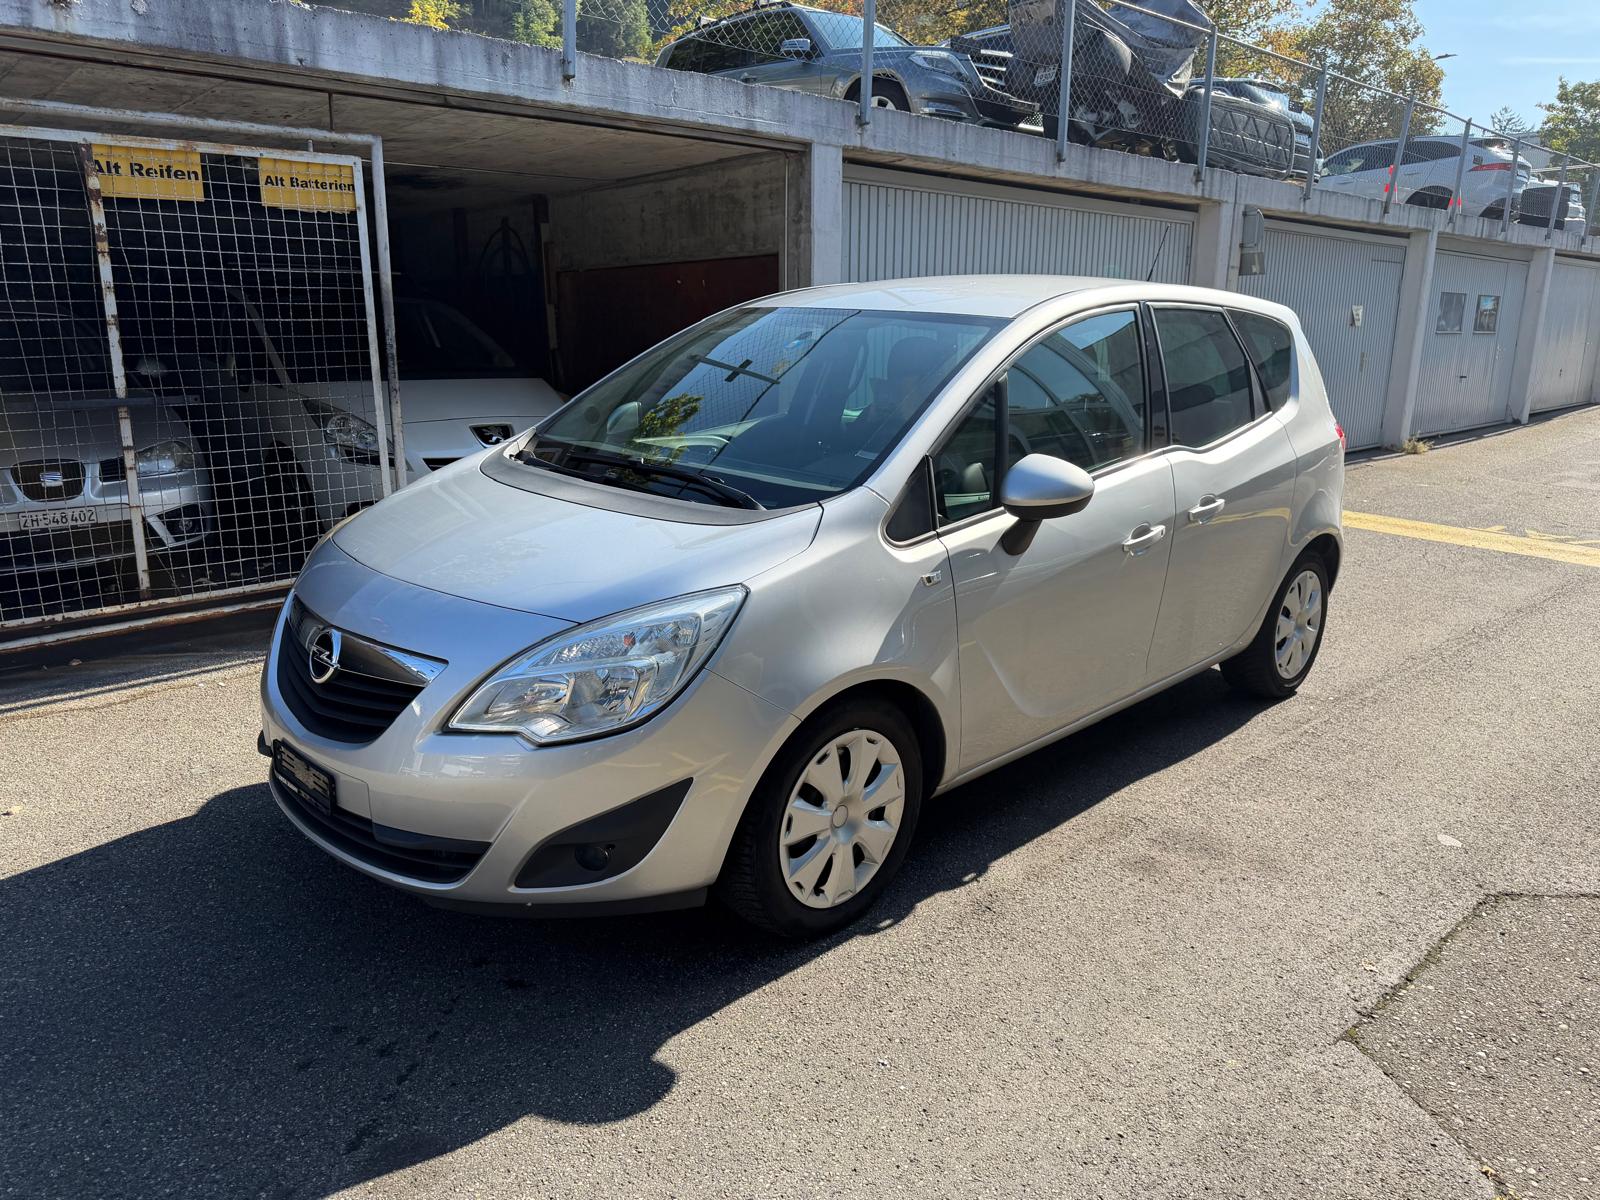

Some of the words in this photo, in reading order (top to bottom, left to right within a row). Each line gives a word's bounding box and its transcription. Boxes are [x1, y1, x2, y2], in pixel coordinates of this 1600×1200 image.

[94, 160, 121, 175] Alt
[129, 162, 200, 181] Reifen
[264, 175, 285, 187] Alt
[290, 176, 355, 191] Batterien
